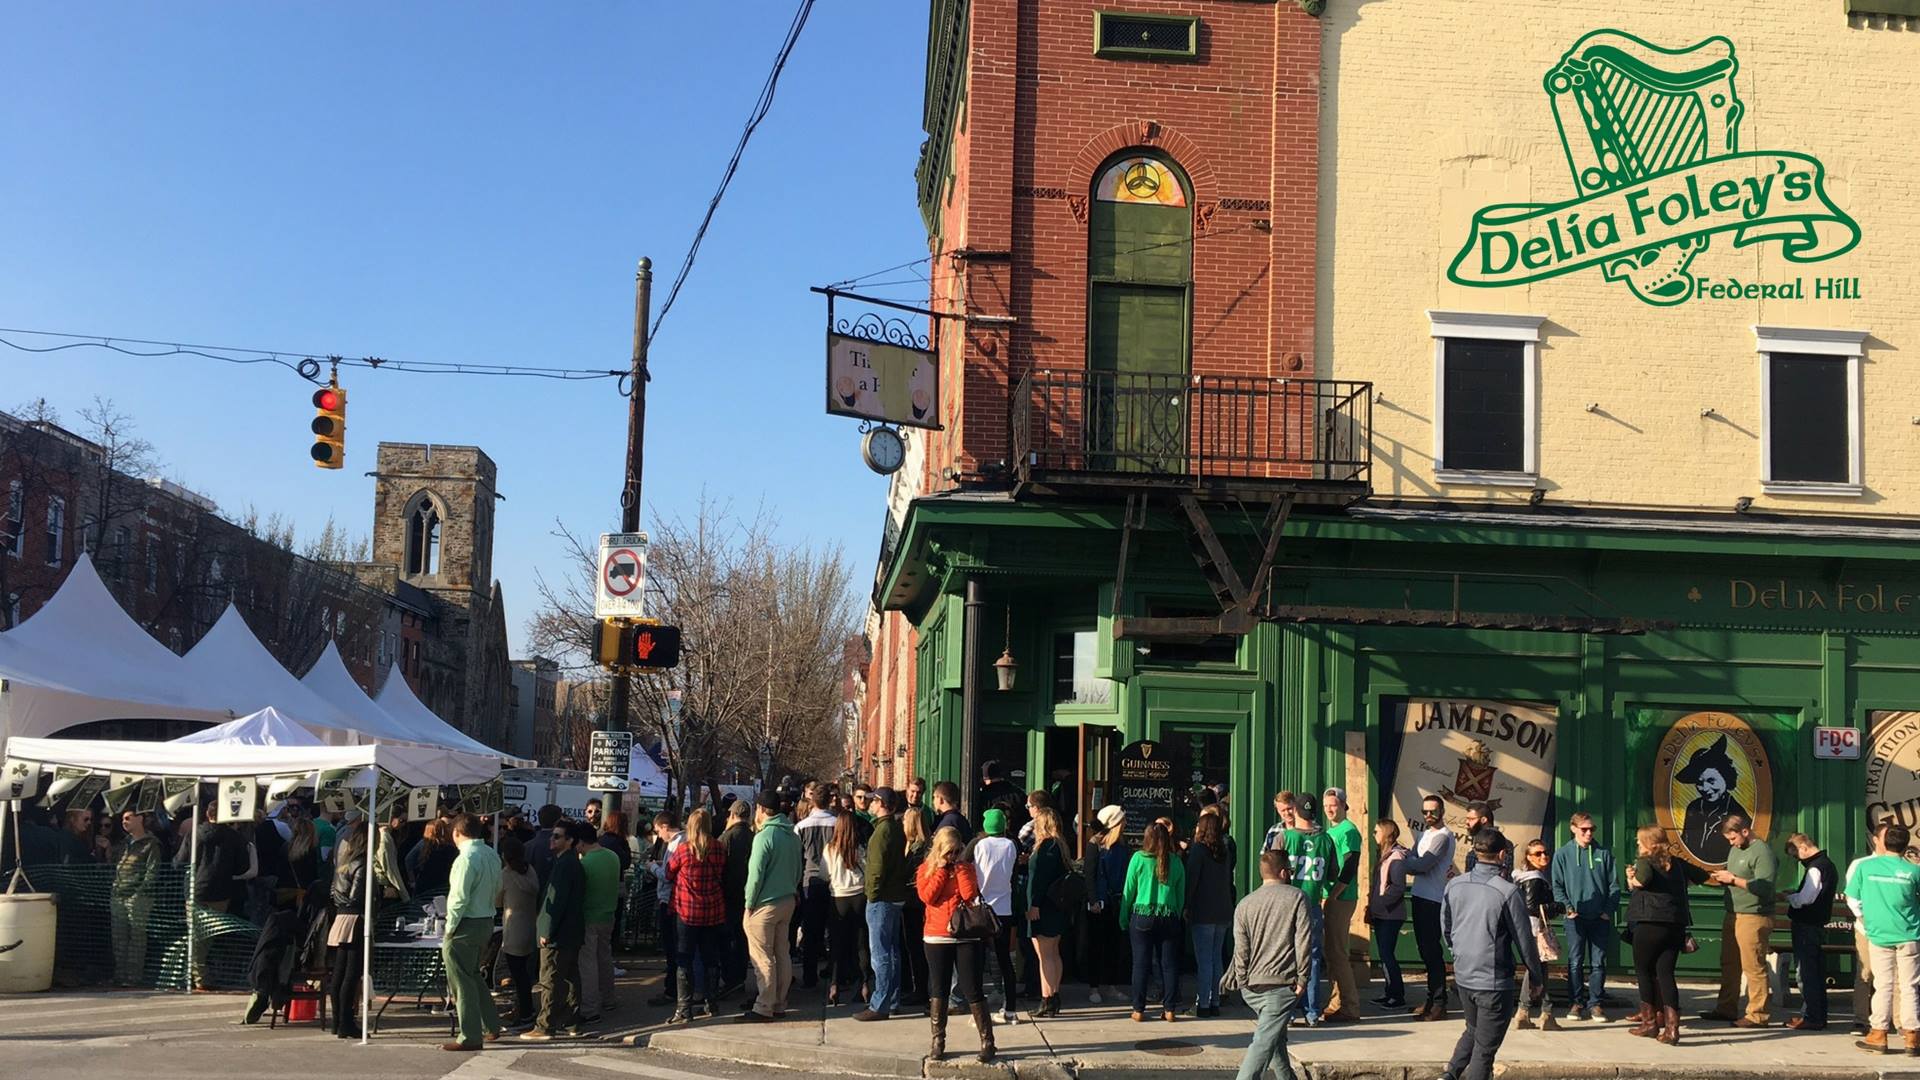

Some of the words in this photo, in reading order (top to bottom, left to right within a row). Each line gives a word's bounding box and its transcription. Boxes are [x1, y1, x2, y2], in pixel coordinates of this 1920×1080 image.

[1838, 584, 1920, 613] Fole
[1415, 701, 1553, 760] JAMESON
[605, 739, 619, 747] NO
[1819, 730, 1854, 748] FDC
[593, 747, 629, 756] PARKING
[1866, 719, 1920, 796] TRADITION
[1121, 758, 1170, 769] GUINNESS
[1123, 786, 1149, 798] BLOCK
[1149, 786, 1174, 801] PARTY
[1838, 921, 1853, 930] City
